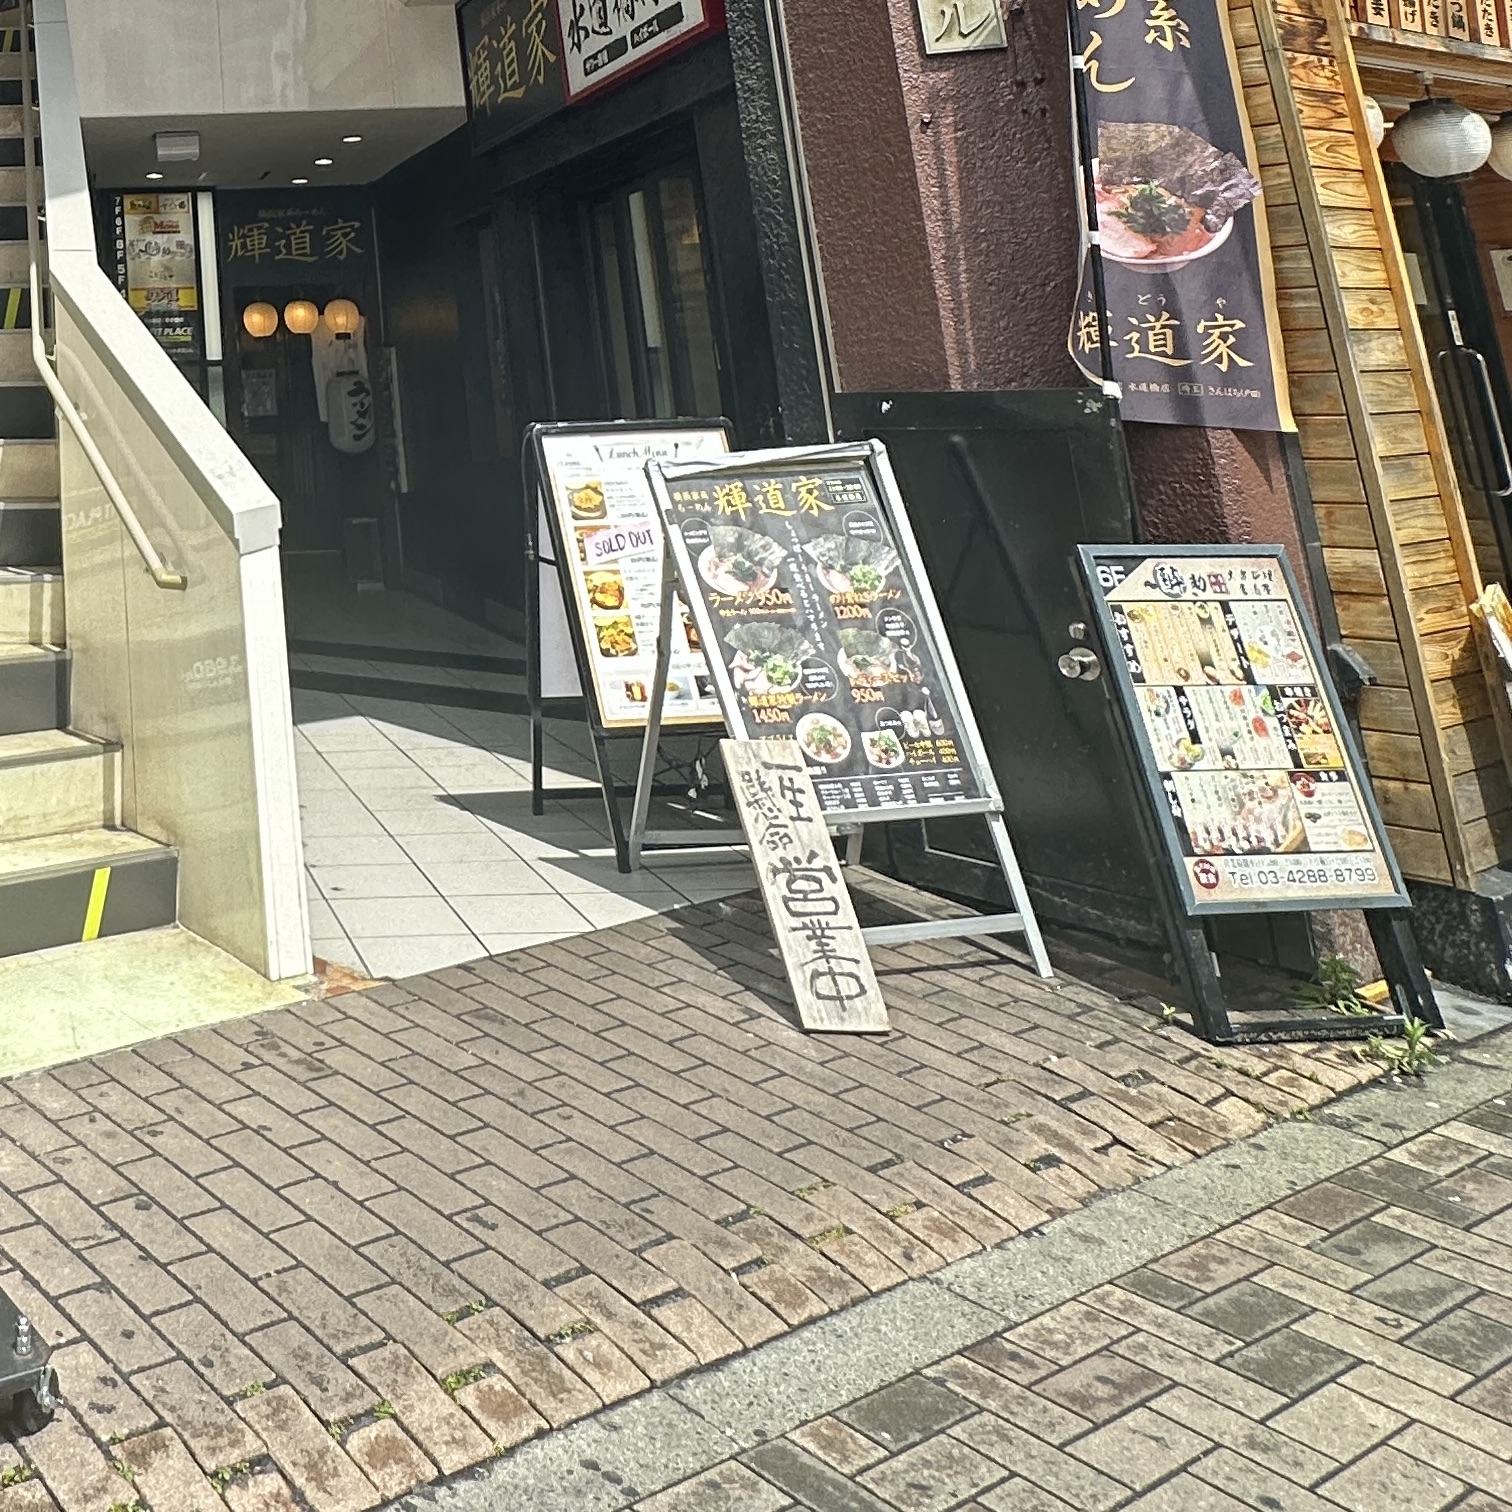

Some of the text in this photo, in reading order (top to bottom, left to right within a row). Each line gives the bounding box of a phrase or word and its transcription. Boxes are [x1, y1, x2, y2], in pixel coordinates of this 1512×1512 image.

[227, 217, 365, 264] 輝道家
[712, 475, 836, 521] 輝道家
[595, 533, 626, 558] SOLD
[629, 528, 654, 549] OUT
[772, 849, 868, 1012] 営業中
